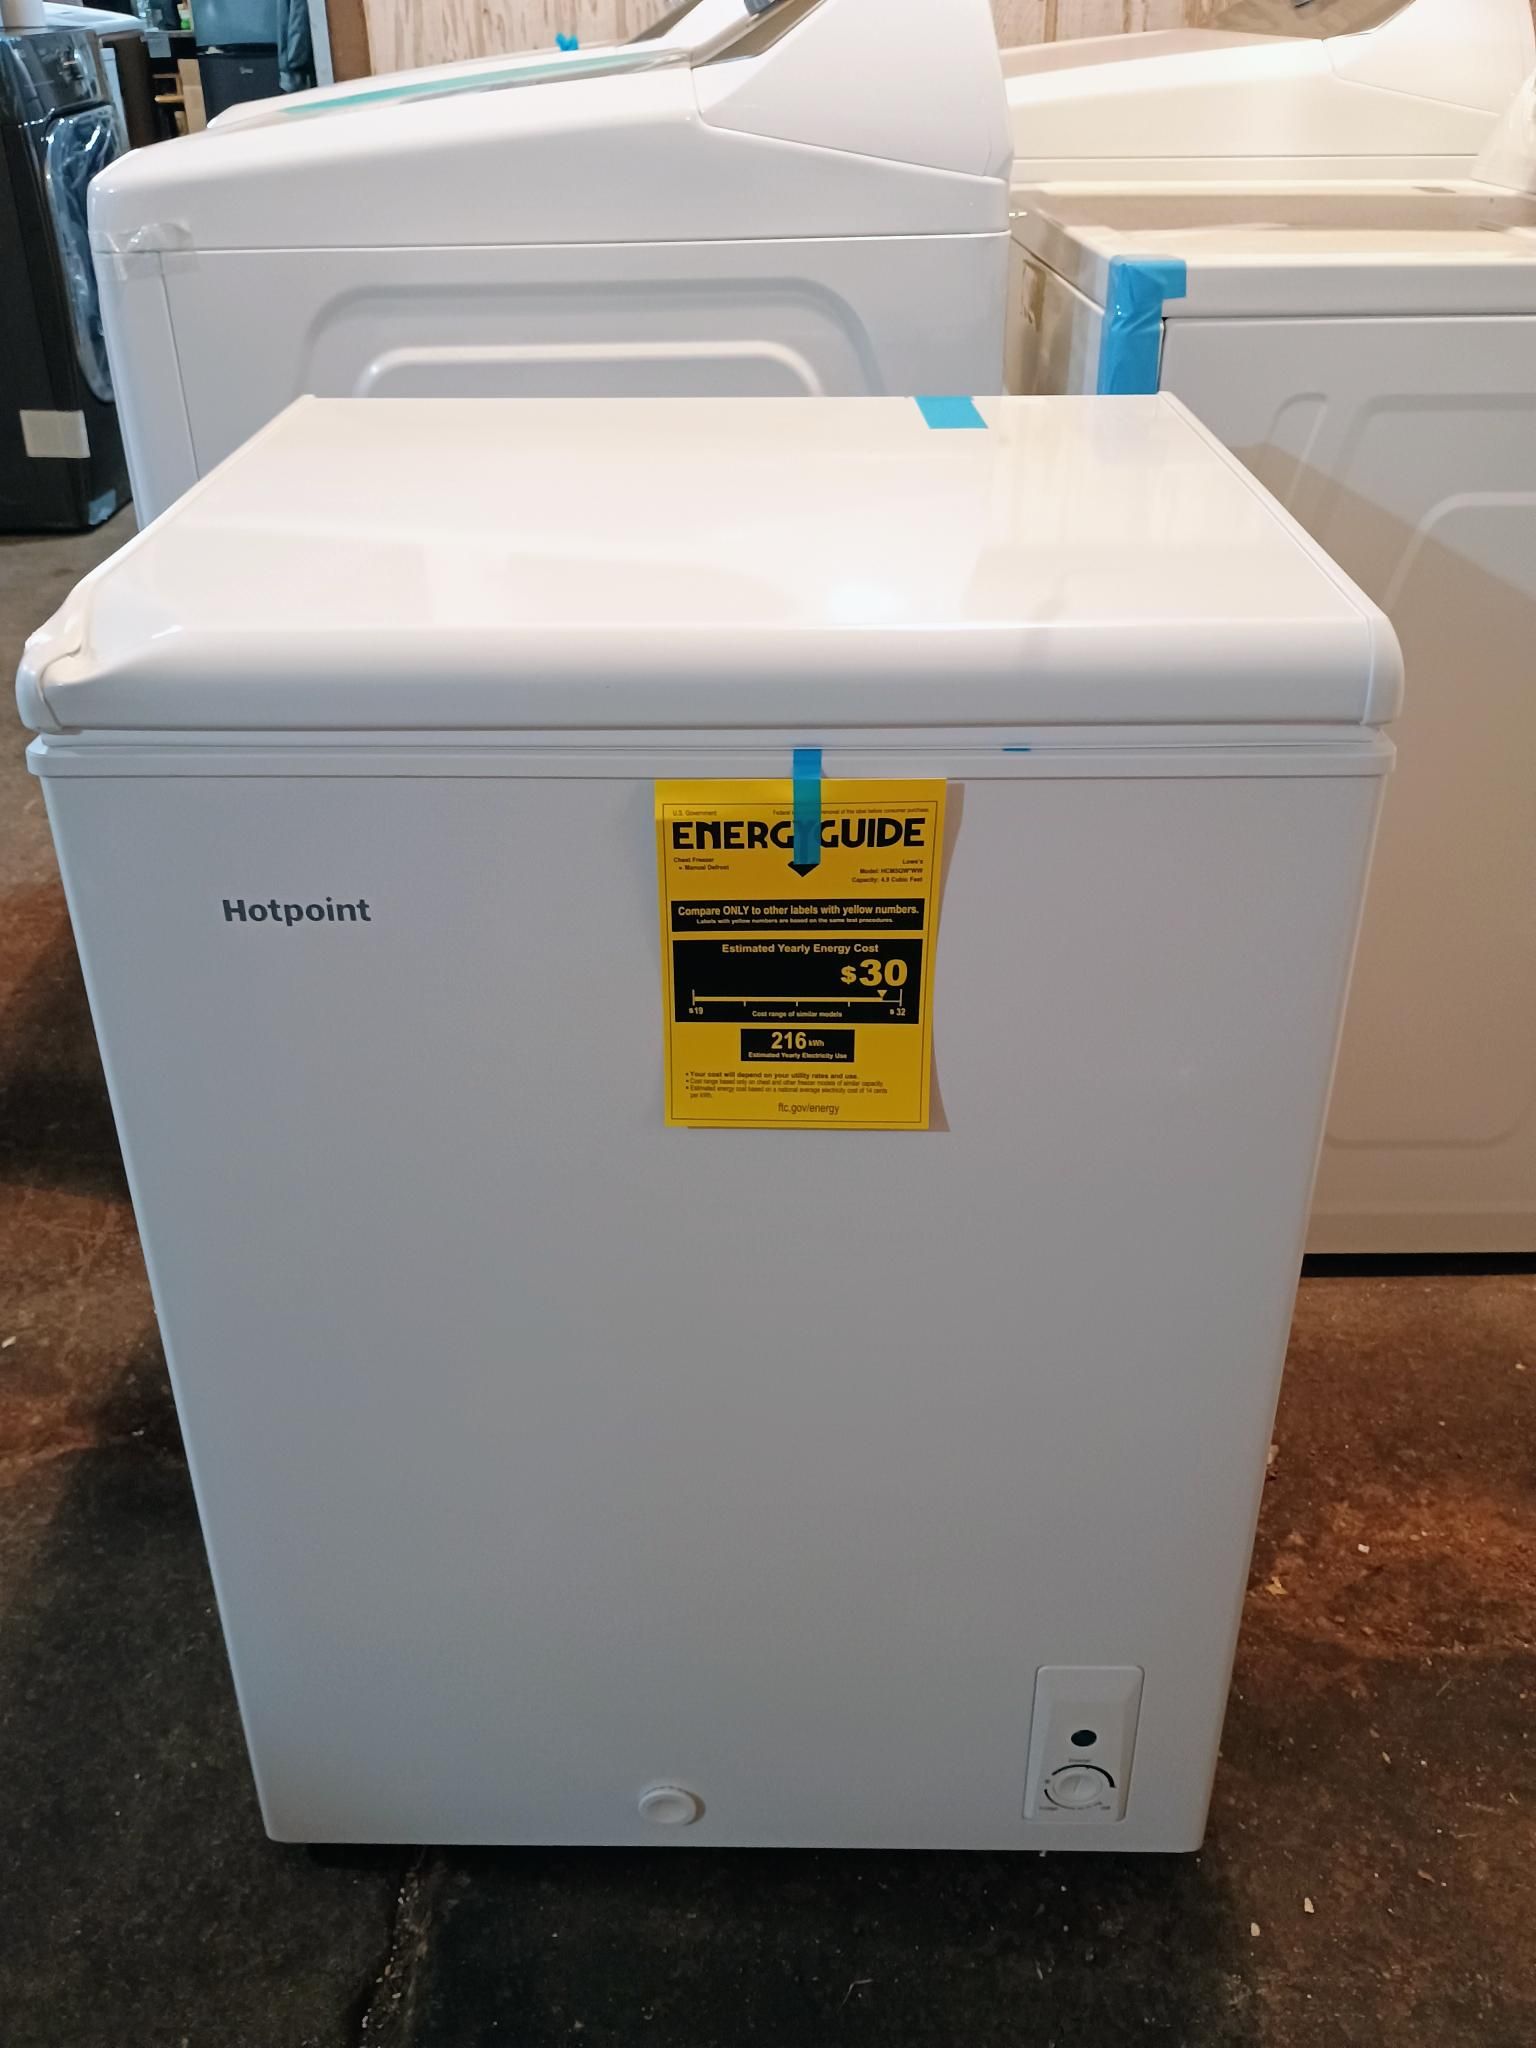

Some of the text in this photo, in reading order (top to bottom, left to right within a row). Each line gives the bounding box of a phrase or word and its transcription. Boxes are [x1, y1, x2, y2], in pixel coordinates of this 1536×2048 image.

[222, 896, 372, 926] Hotpoint
[678, 904, 919, 917] Compare ONLY to other labels with yellow numbers.
[722, 944, 879, 954] Estimated Yearly Energy Cost
[840, 959, 907, 986] $30
[771, 1032, 806, 1049] 216
[778, 1102, 840, 1115] ftc.gov/energy
